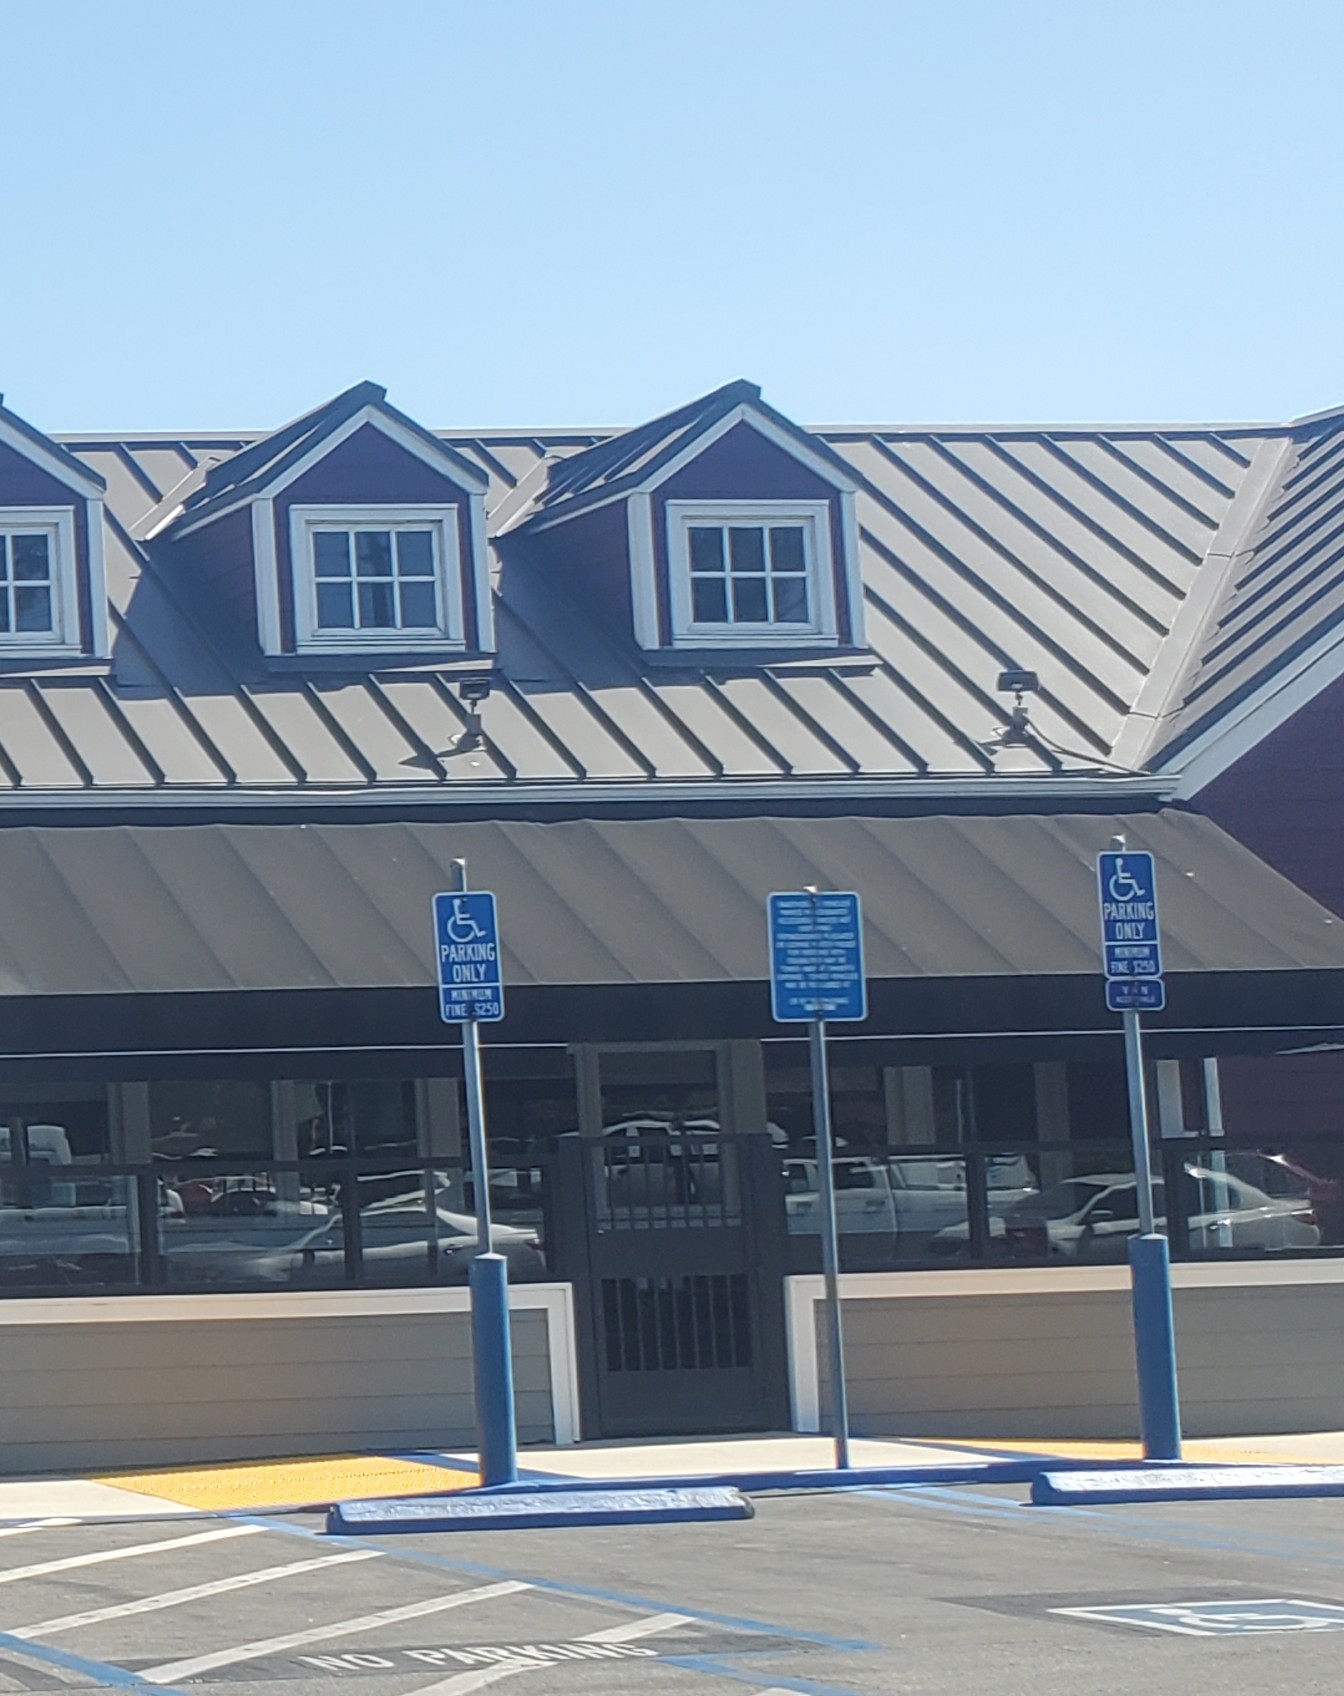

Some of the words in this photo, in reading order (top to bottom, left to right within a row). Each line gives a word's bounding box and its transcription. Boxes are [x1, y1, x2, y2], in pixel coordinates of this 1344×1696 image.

[1103, 902, 1154, 920] PARKING
[1115, 922, 1145, 939] ONLY
[441, 943, 496, 962] PARKING
[452, 964, 486, 982] ONLY
[451, 989, 492, 1001] MINIMUM
[446, 1004, 466, 1016] FINE
[474, 1003, 499, 1015] $250
[297, 1652, 395, 1671] NO
[402, 1642, 660, 1666] PARKING
